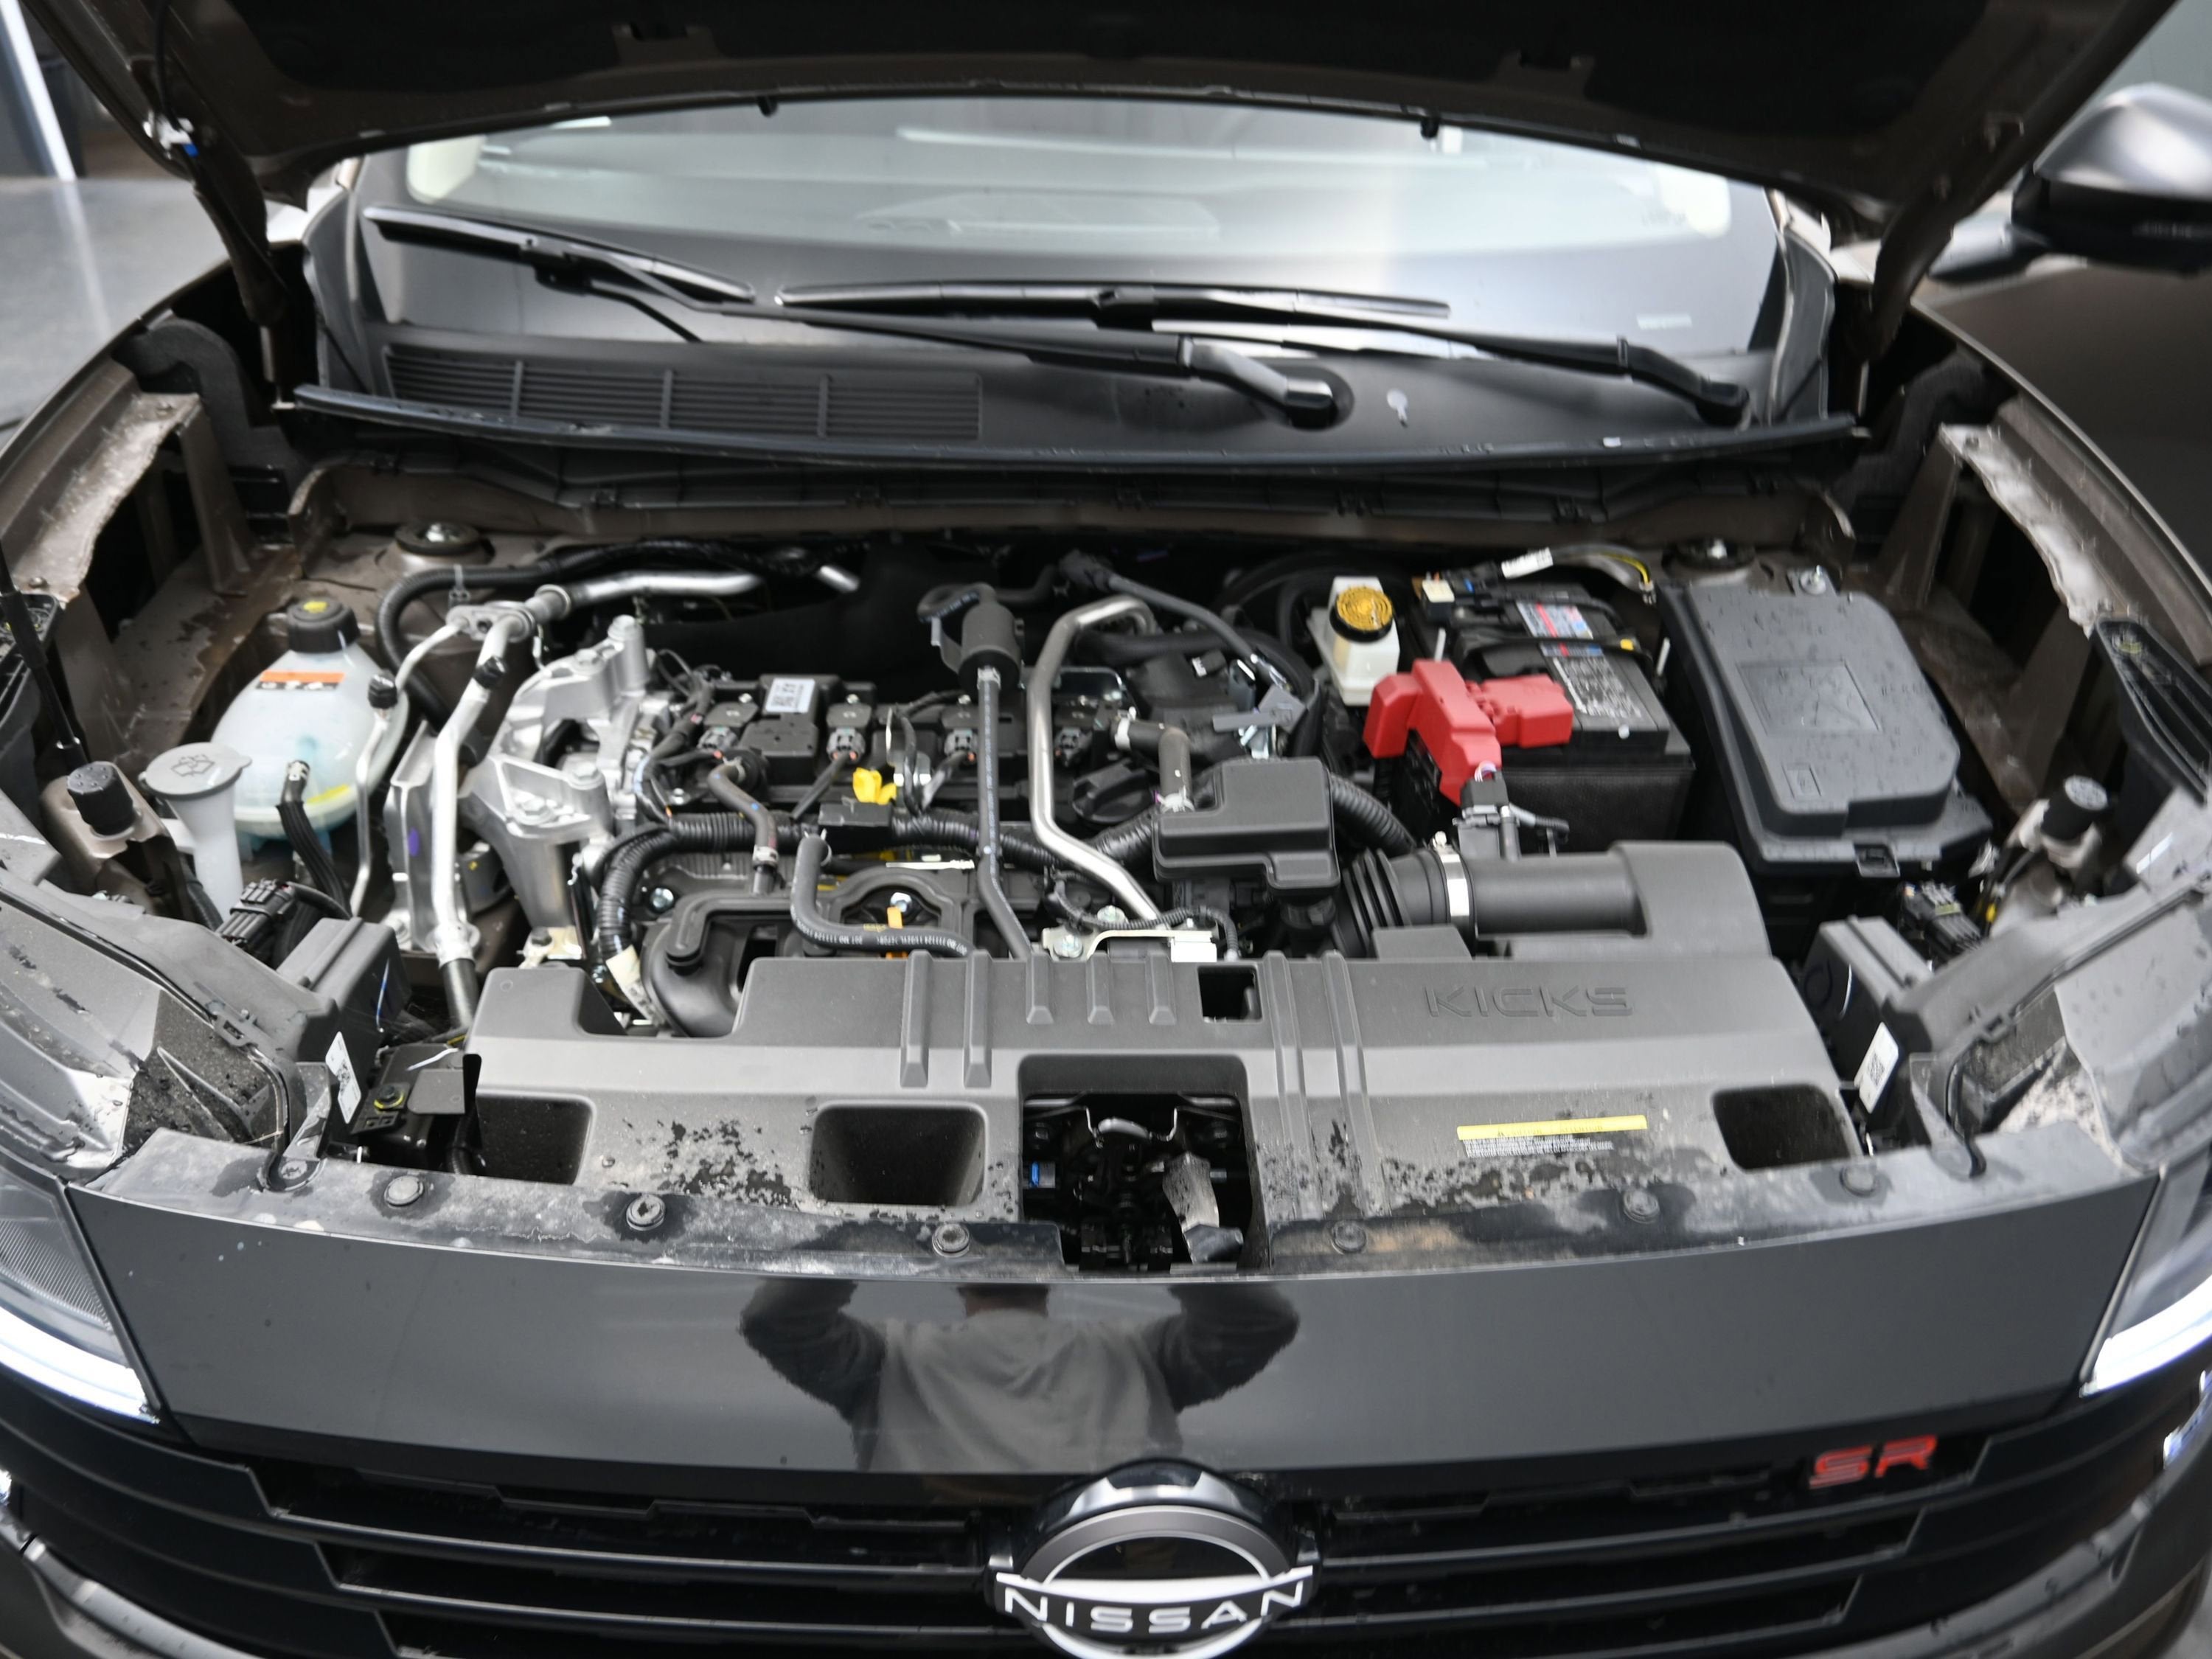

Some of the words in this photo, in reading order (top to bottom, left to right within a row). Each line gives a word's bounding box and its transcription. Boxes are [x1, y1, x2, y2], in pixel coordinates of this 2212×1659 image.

[1424, 984, 1633, 1018] KICKS
[1809, 1434, 1938, 1490] SR
[1004, 1580, 1304, 1634] NISSAN
